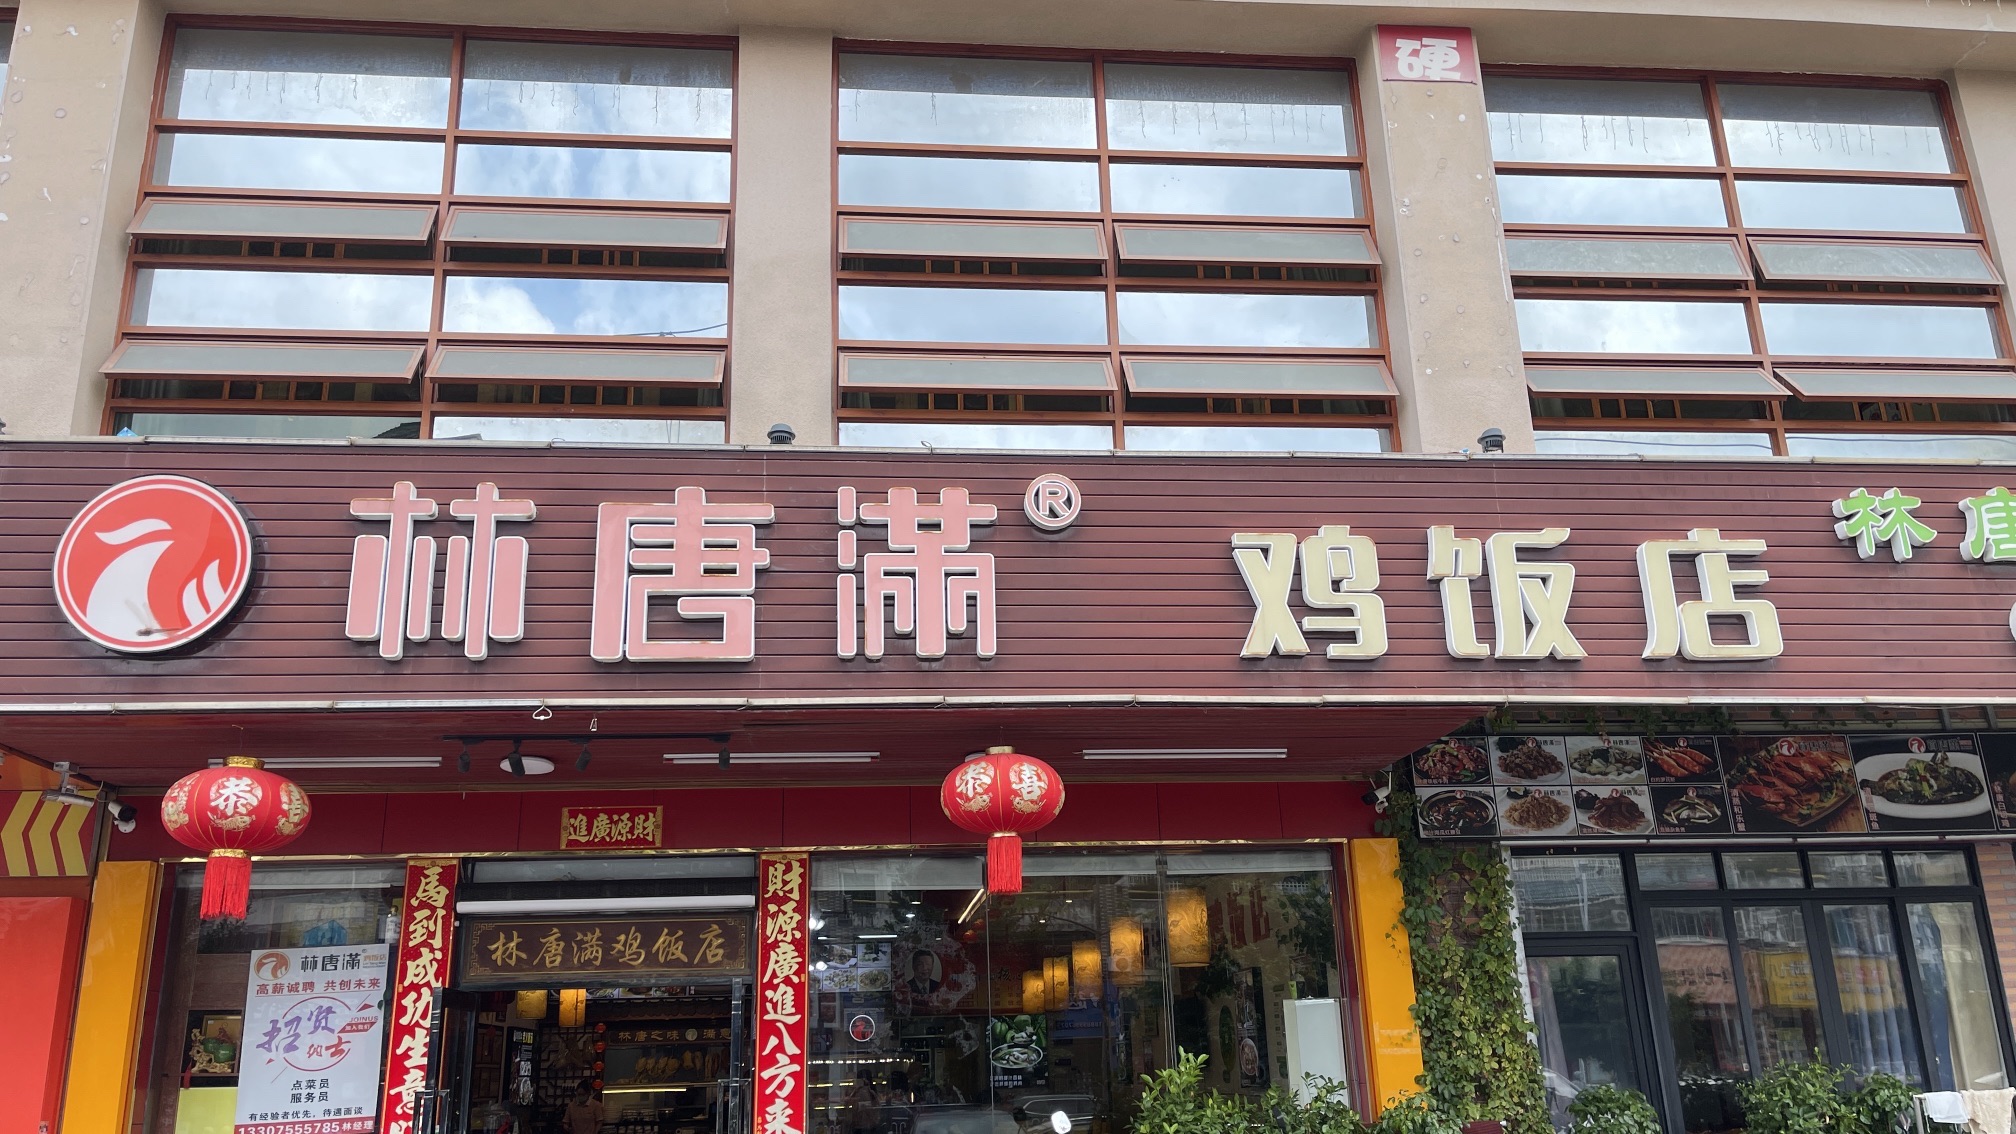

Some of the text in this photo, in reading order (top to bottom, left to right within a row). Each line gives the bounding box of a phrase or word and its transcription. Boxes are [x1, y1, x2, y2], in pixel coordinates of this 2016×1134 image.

[1395, 37, 1461, 80] 硬
[1832, 486, 2016, 562] 林唐
[344, 480, 998, 663] 林唐满
[1231, 524, 1786, 661] 鸡饭店
[487, 926, 726, 967] 林唐满鸡饭店
[300, 952, 362, 972] 林唐满
[256, 977, 381, 995] 高薪诚聘 共创未来
[618, 1030, 680, 1042] 林唐之味
[290, 1078, 330, 1091] 点菜员
[289, 1091, 329, 1104] 服务员
[237, 1120, 374, 1134] 13307555785 林经理
